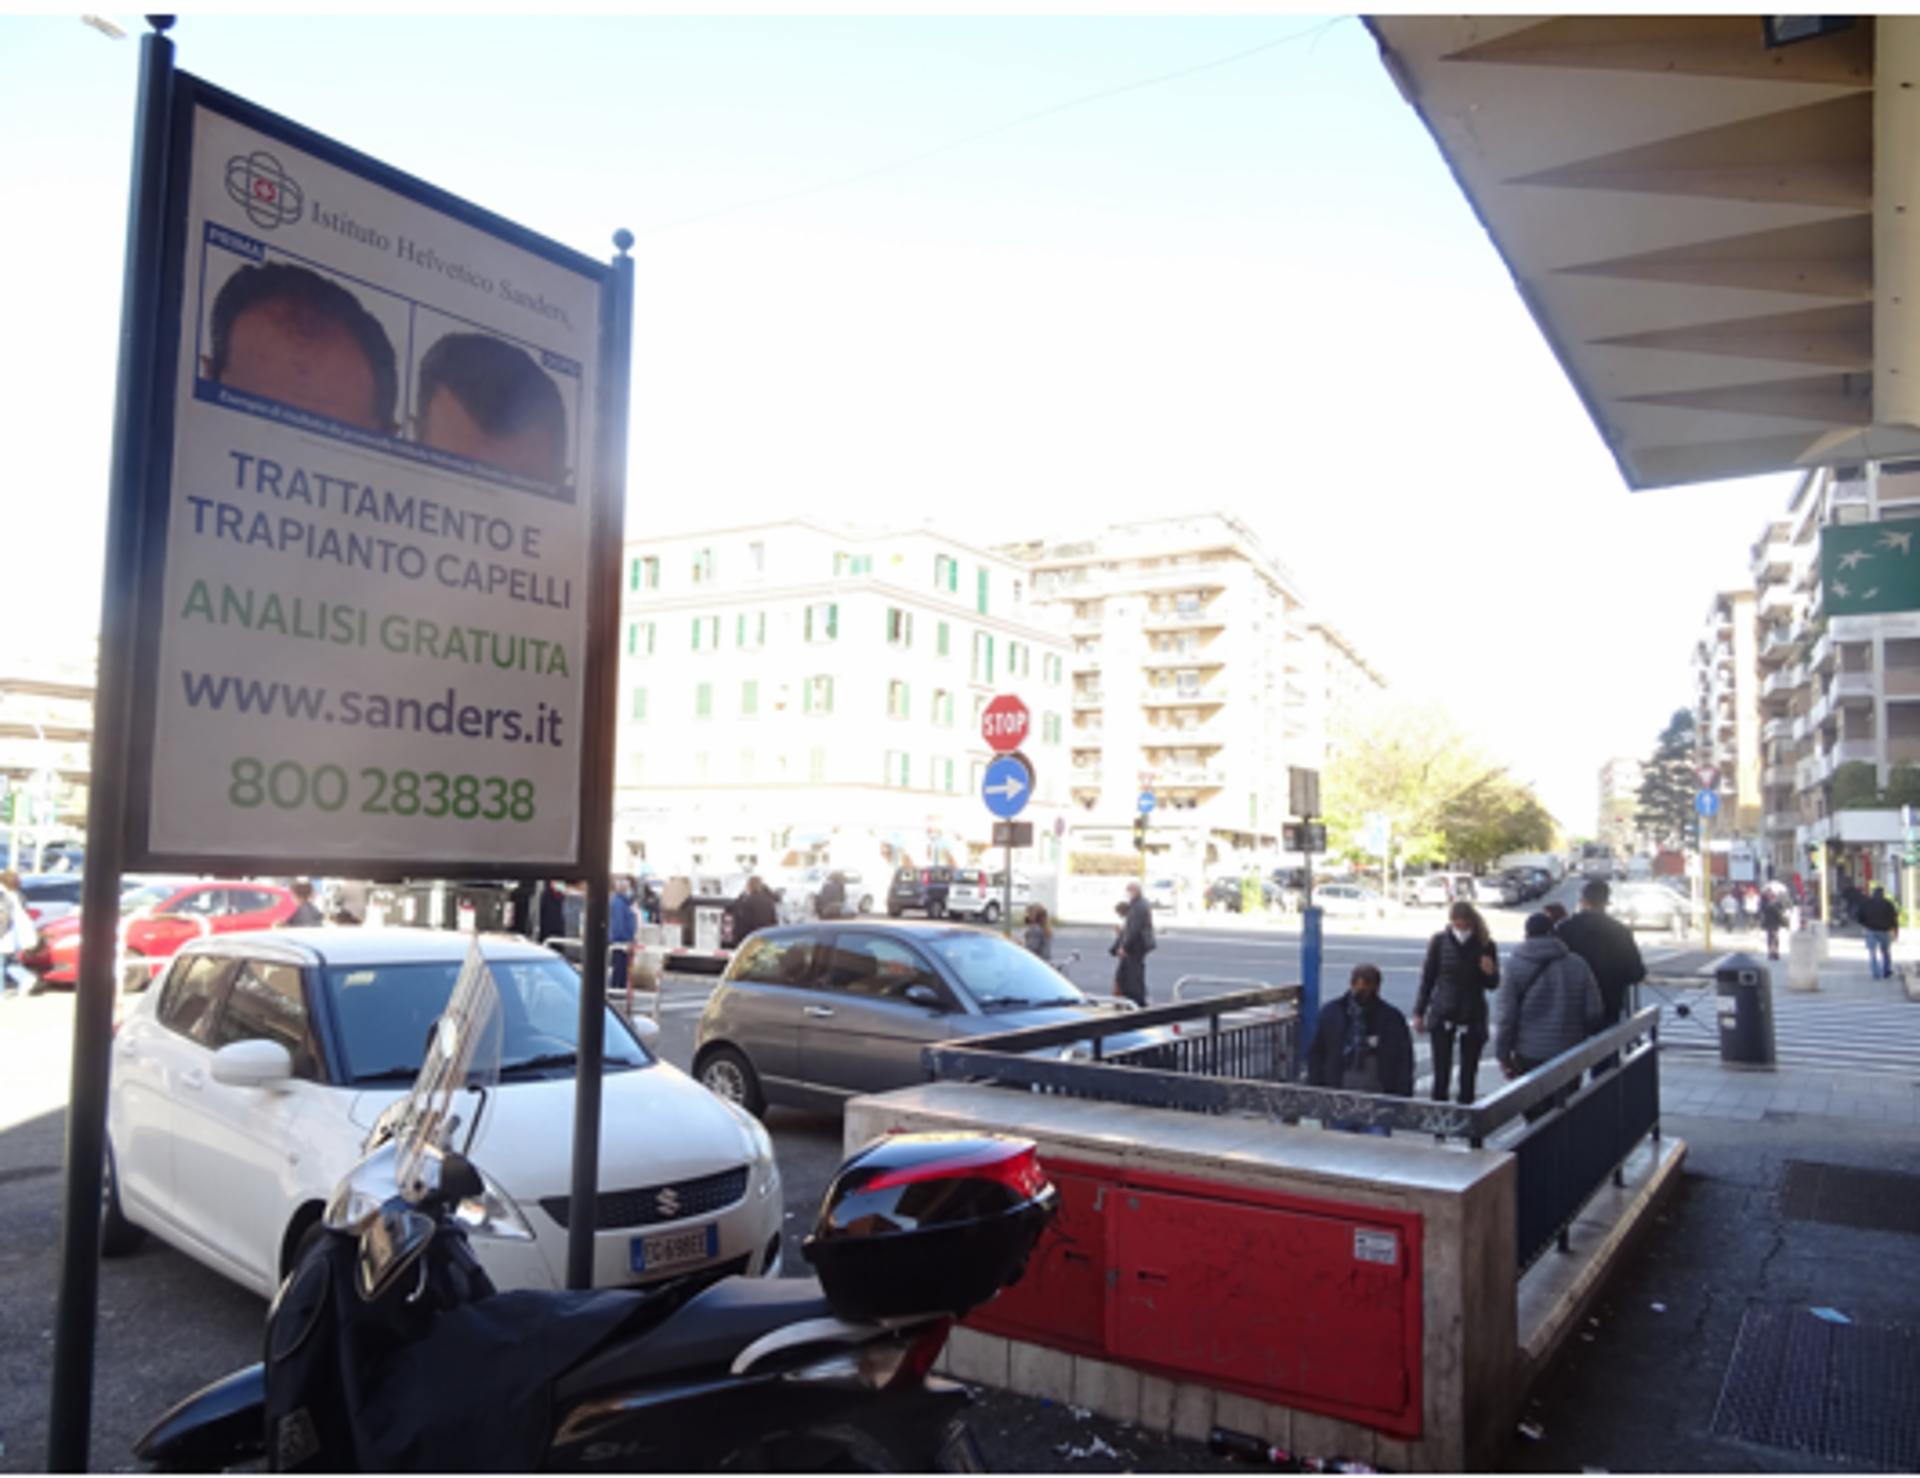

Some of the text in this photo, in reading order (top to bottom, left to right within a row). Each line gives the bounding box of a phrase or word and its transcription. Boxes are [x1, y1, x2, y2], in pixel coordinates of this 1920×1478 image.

[311, 202, 391, 251] Istituto
[397, 235, 495, 294] Helvetico
[229, 450, 514, 553] TRATTAMENTO
[522, 526, 541, 559] E
[187, 495, 571, 609] TRAPIANTO CAPELLI
[181, 579, 570, 677] ANALISI GRATUITA
[182, 670, 563, 747] www.sanders.it
[983, 711, 1025, 735] STOP
[228, 757, 536, 822] 800 283838
